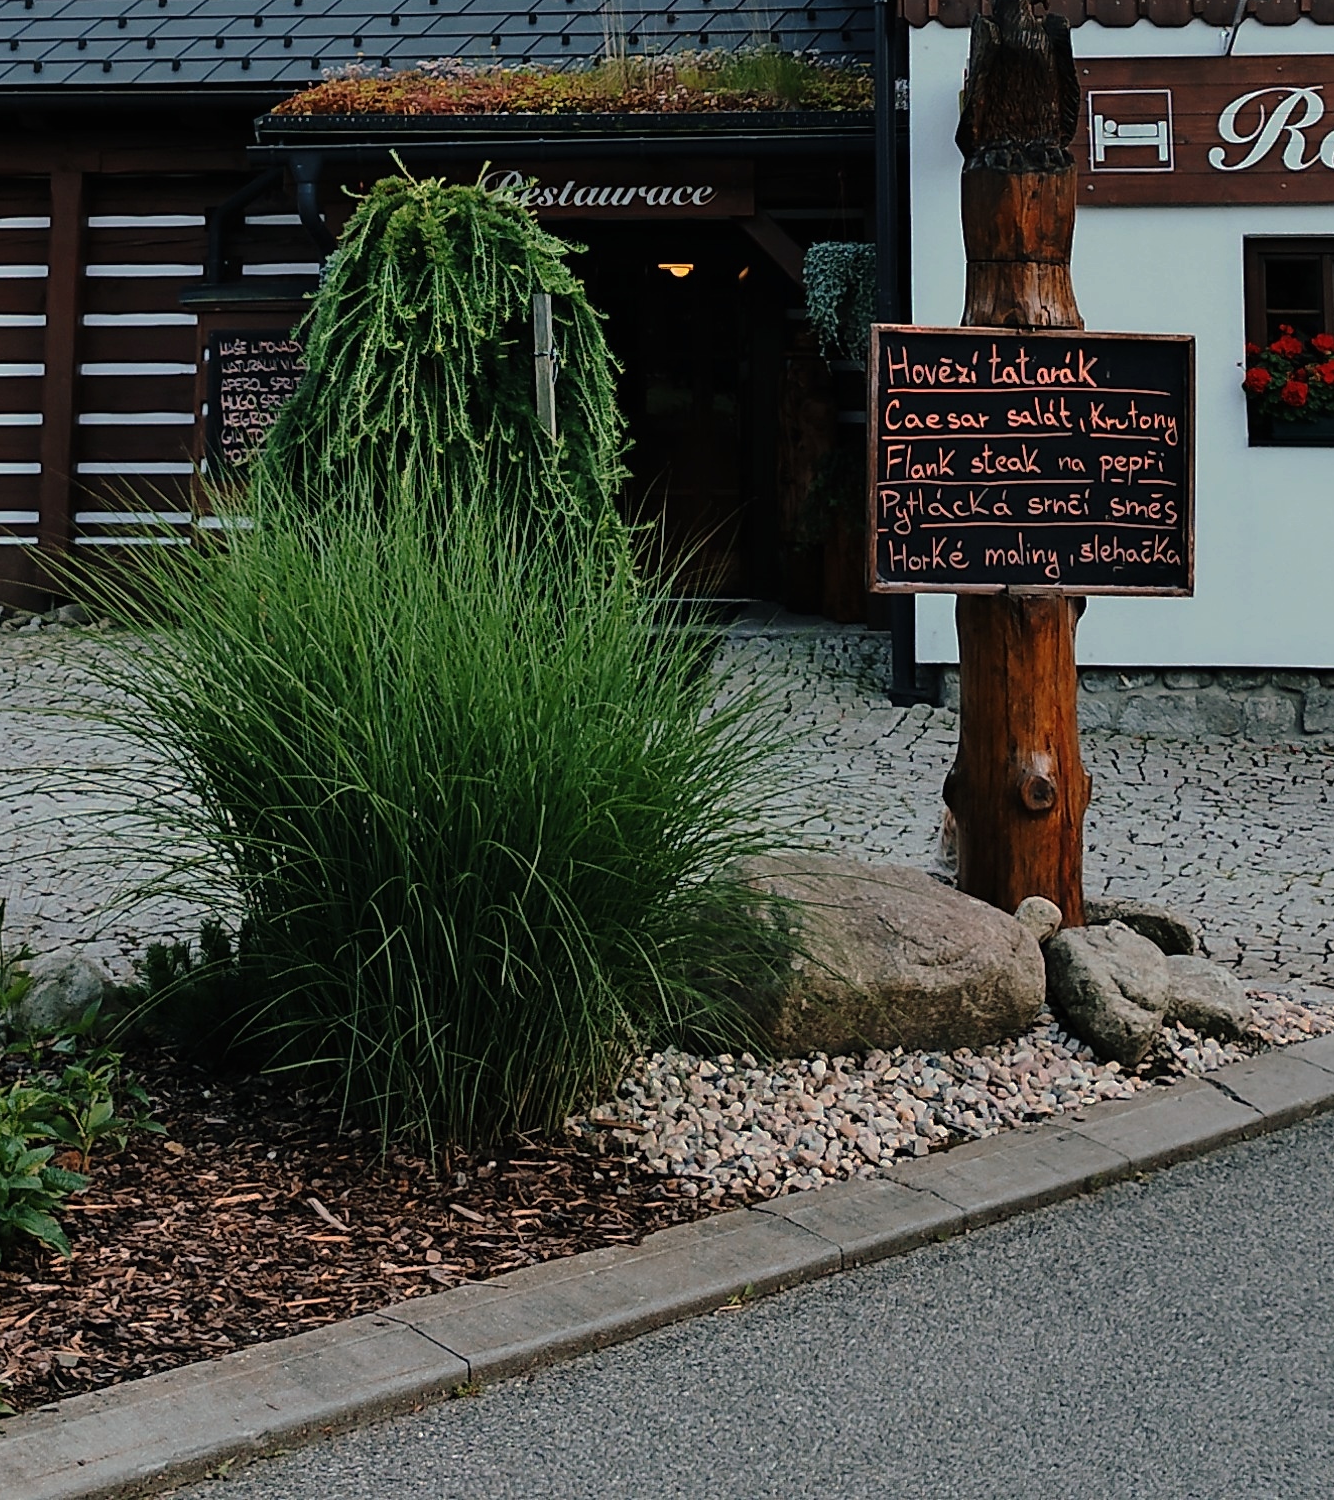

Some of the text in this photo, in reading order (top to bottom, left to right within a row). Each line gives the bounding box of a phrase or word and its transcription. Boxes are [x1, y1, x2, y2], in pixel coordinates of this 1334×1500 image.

[480, 168, 718, 207] Restaurace
[220, 376, 302, 393] APEROL SPRIT
[220, 394, 258, 411] HUGO
[885, 398, 991, 431] Caesar
[970, 443, 1043, 475] steak
[1058, 456, 1087, 474] na
